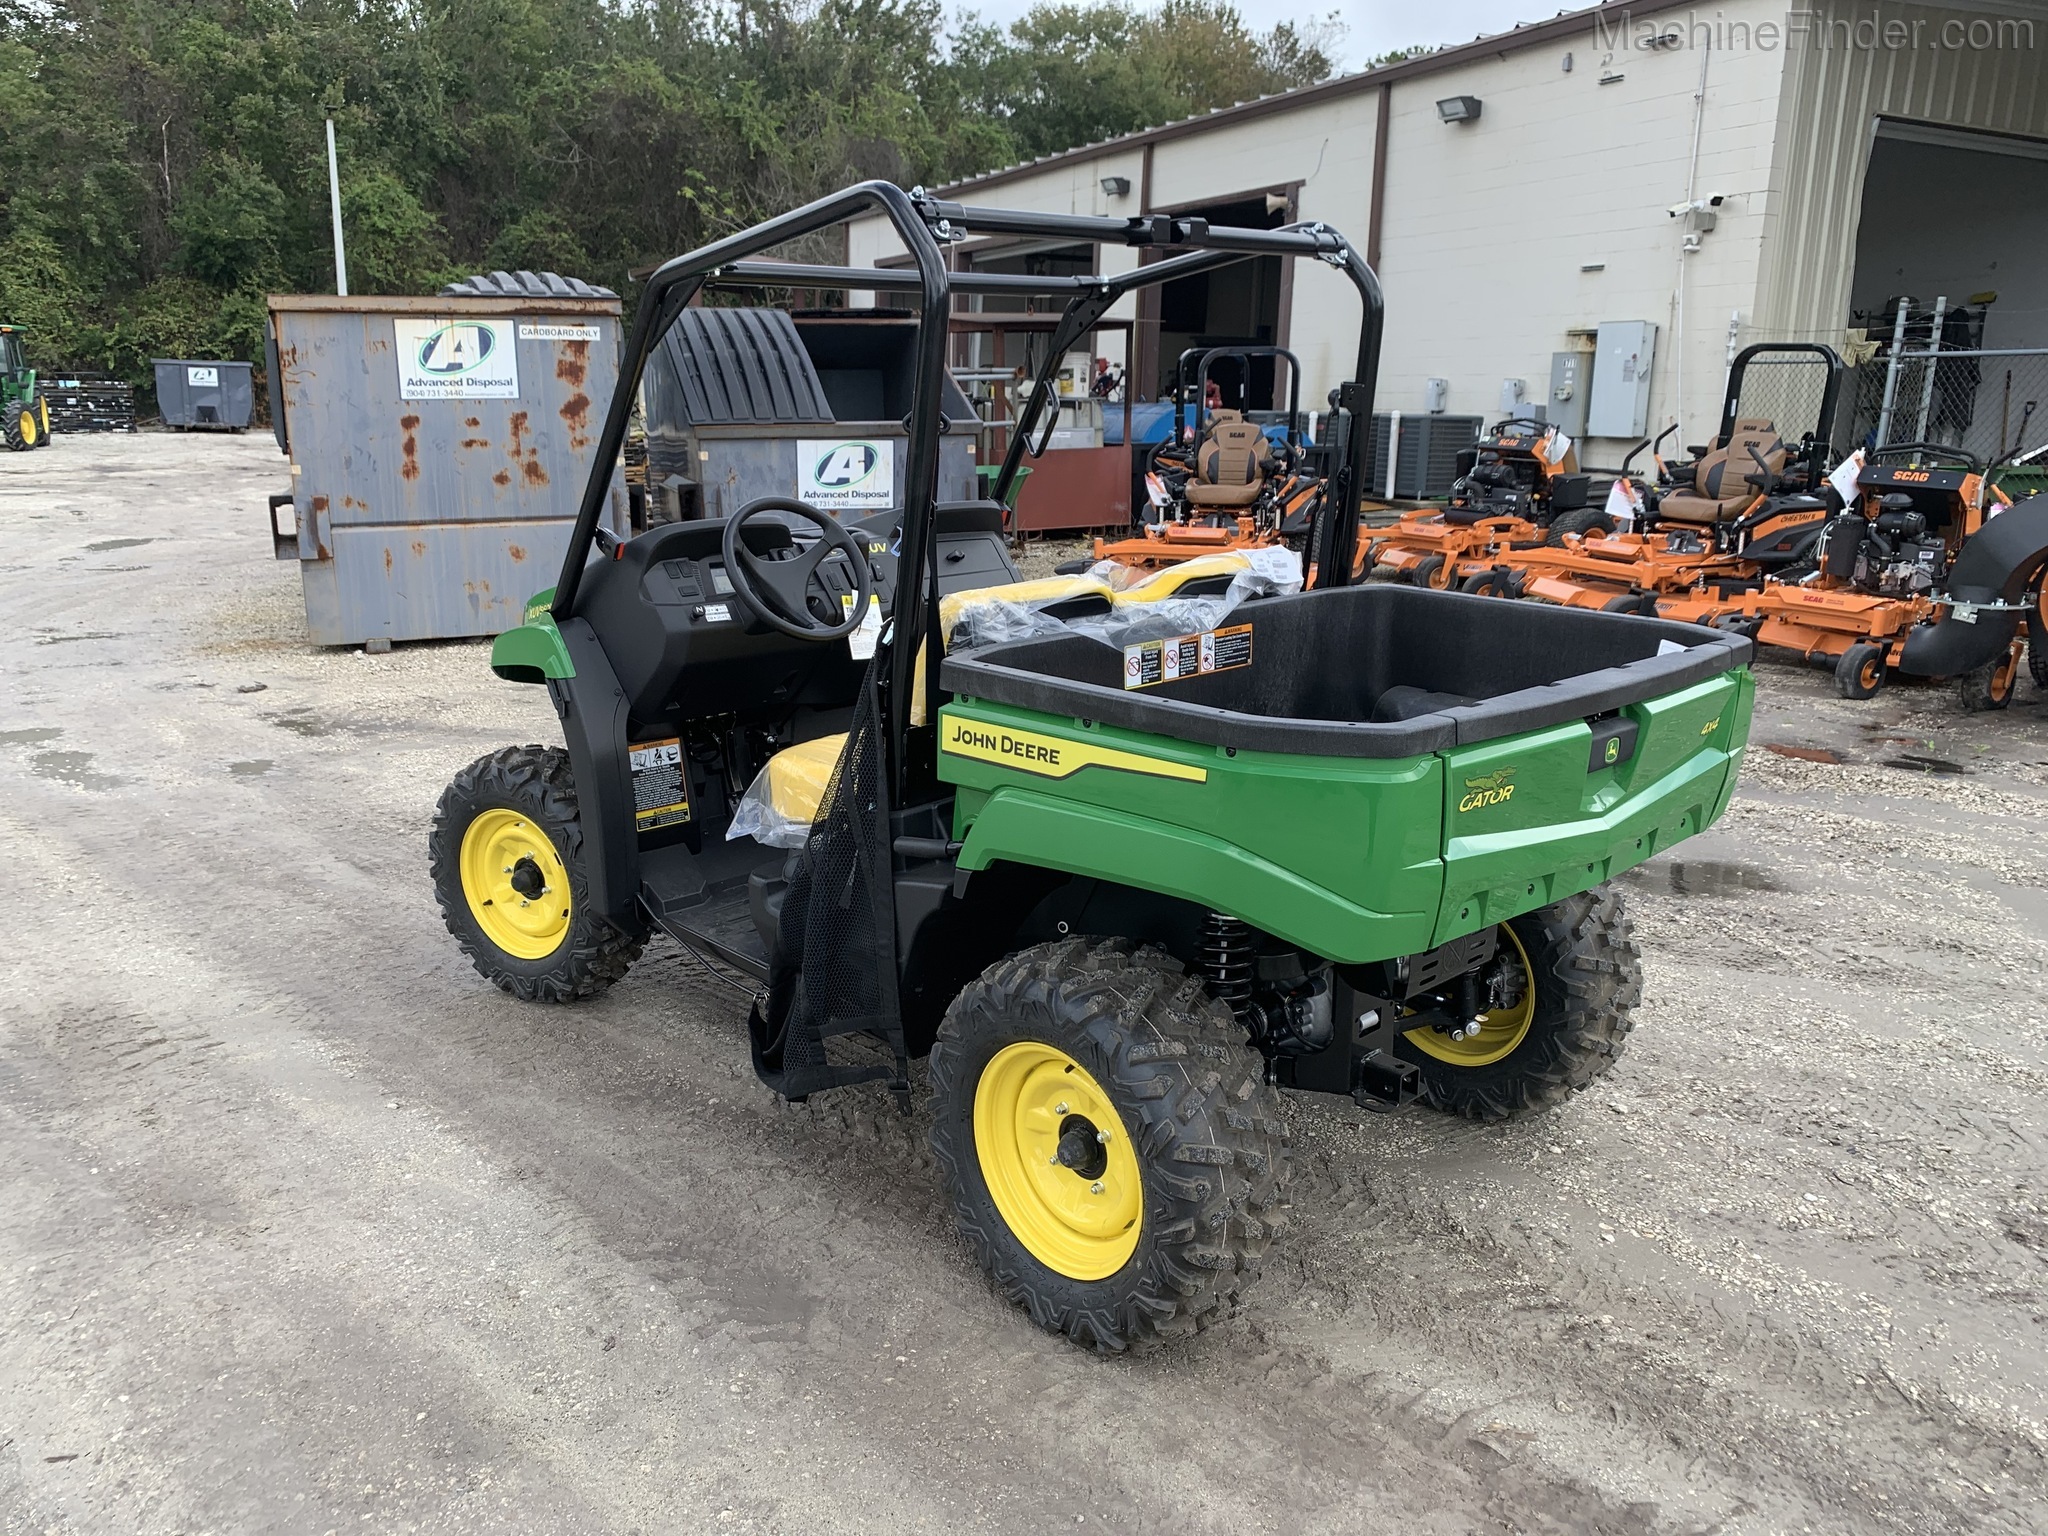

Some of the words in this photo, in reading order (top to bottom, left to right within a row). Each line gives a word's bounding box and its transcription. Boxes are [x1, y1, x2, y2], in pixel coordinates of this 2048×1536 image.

[521, 327, 575, 337] CARDBOARD
[576, 329, 599, 338] ONLY
[406, 377, 464, 387] Advanced
[466, 377, 514, 389] Disposal
[426, 389, 464, 397] 731-3440
[1498, 438, 1520, 447] SCAG
[1892, 470, 1930, 482] SCAG
[803, 490, 850, 499] Advanced
[851, 490, 890, 500] Disposal
[868, 543, 886, 553] UV
[1802, 594, 1824, 604] SCAG
[695, 605, 704, 614] N
[952, 725, 997, 751] JOHN
[1001, 735, 1060, 765] DEERE
[1458, 784, 1515, 813] GATOR
